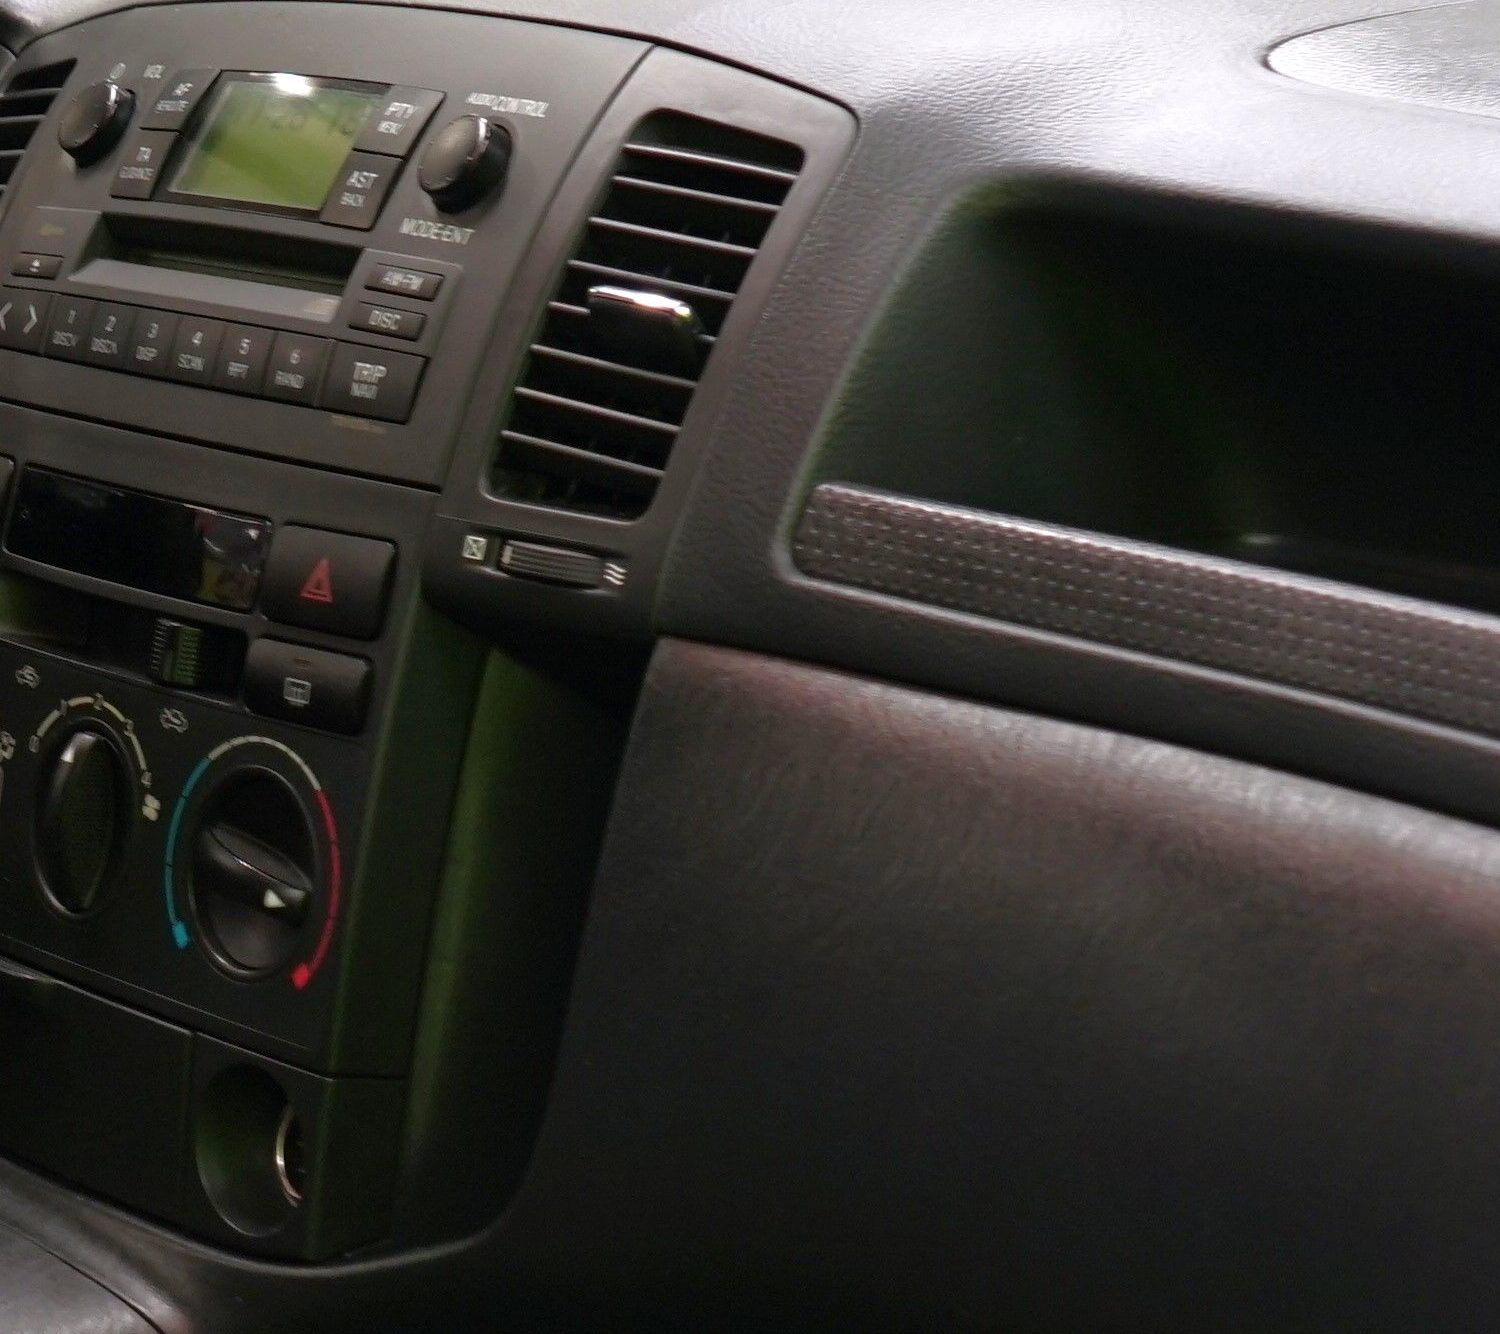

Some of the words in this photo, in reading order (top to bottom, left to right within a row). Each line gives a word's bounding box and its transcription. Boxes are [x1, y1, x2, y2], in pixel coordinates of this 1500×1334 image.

[492, 95, 550, 117] CONTROL
[105, 315, 117, 332] 2
[368, 310, 402, 330] DISC
[147, 322, 159, 339] 3
[191, 331, 203, 345] 4
[239, 338, 251, 355] 5
[289, 348, 301, 365] 6
[353, 361, 388, 382] TRIP
